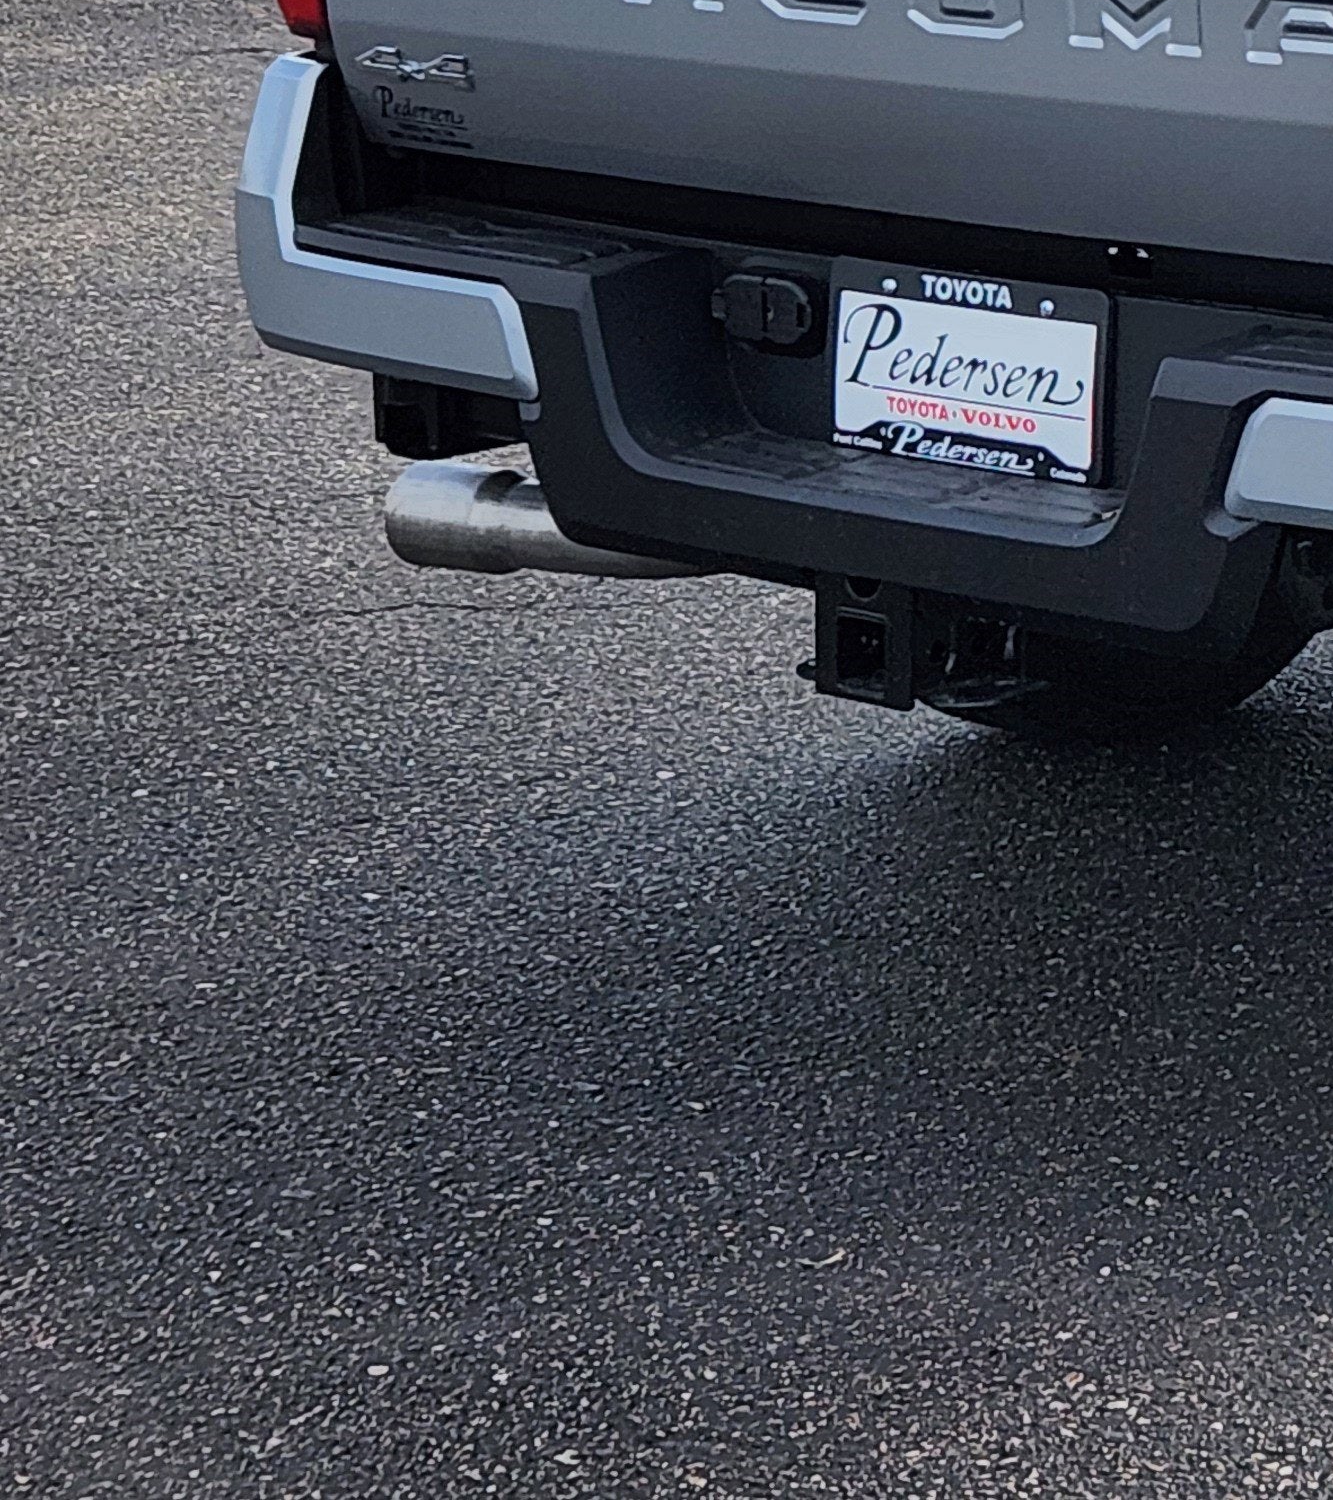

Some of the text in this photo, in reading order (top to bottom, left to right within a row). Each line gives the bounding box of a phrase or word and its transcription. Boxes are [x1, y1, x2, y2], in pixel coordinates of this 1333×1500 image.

[921, 274, 1013, 309] TOYOTA
[843, 303, 1085, 406] Pedersen
[886, 395, 1037, 433] TOYOTA VOLVO
[887, 420, 1035, 471] Pedersen
